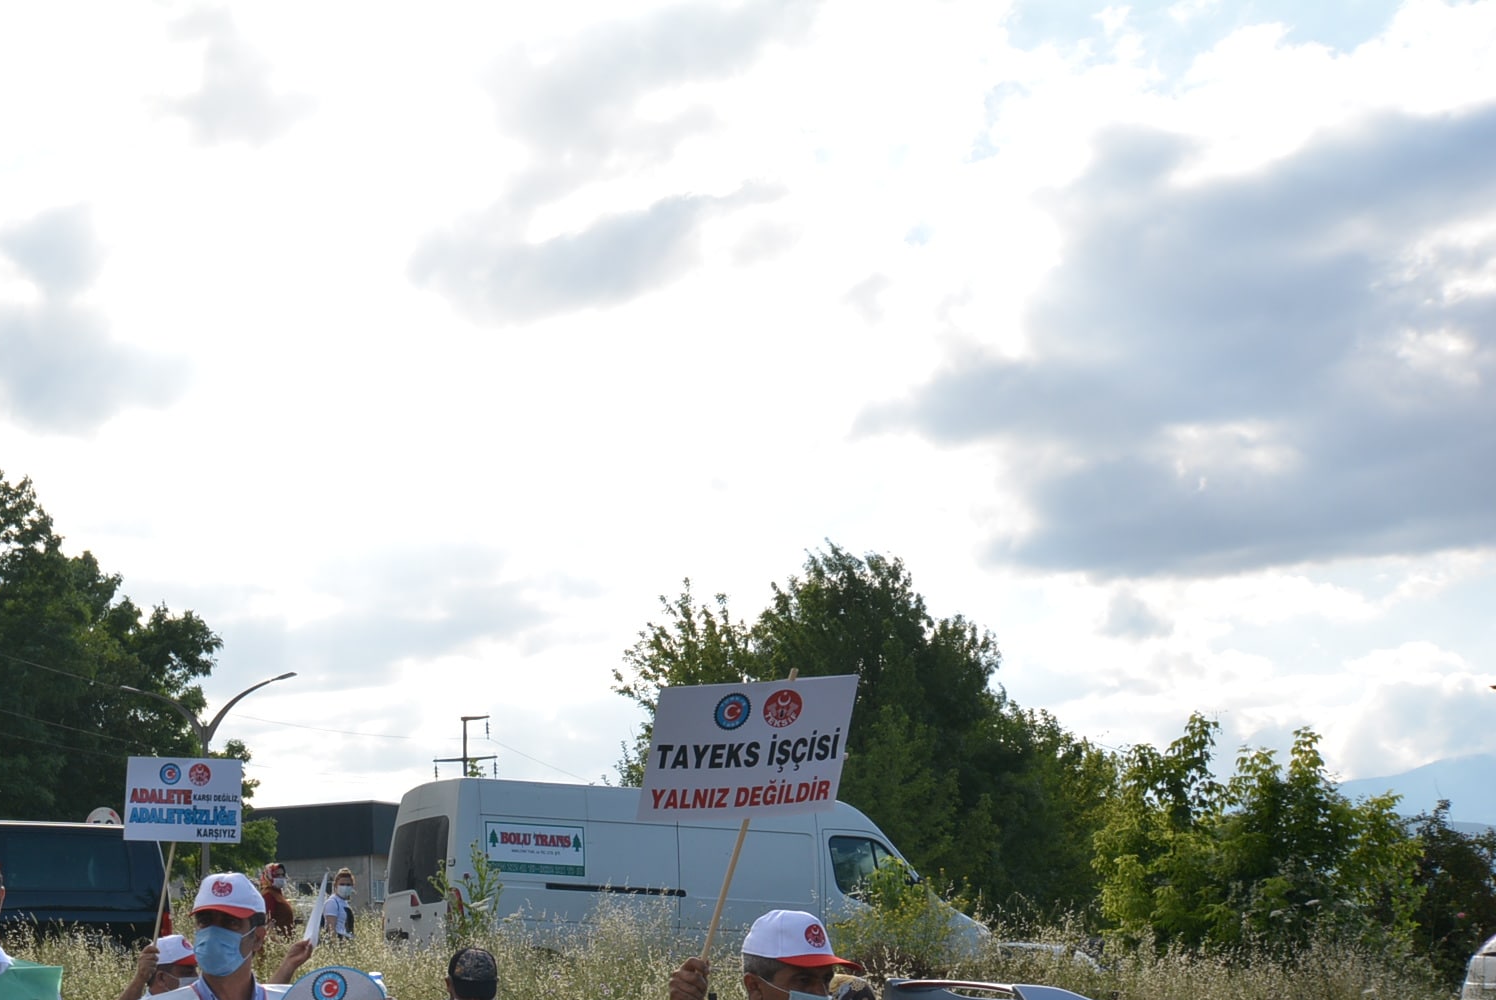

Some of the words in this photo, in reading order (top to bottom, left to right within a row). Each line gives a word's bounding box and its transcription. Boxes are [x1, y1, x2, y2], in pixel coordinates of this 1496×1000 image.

[657, 741, 760, 770] TAYEKS
[767, 727, 841, 773] İŞÇİSİ
[129, 788, 193, 805] ADALETE
[651, 787, 730, 810] YALNIZ
[733, 775, 831, 808] DEĞİLDİR
[129, 805, 237, 826] ADALETSİZLİĞE
[196, 828, 236, 840] KARŞIYIZ
[500, 831, 532, 846] BOLU
[533, 832, 572, 848] TRANS
